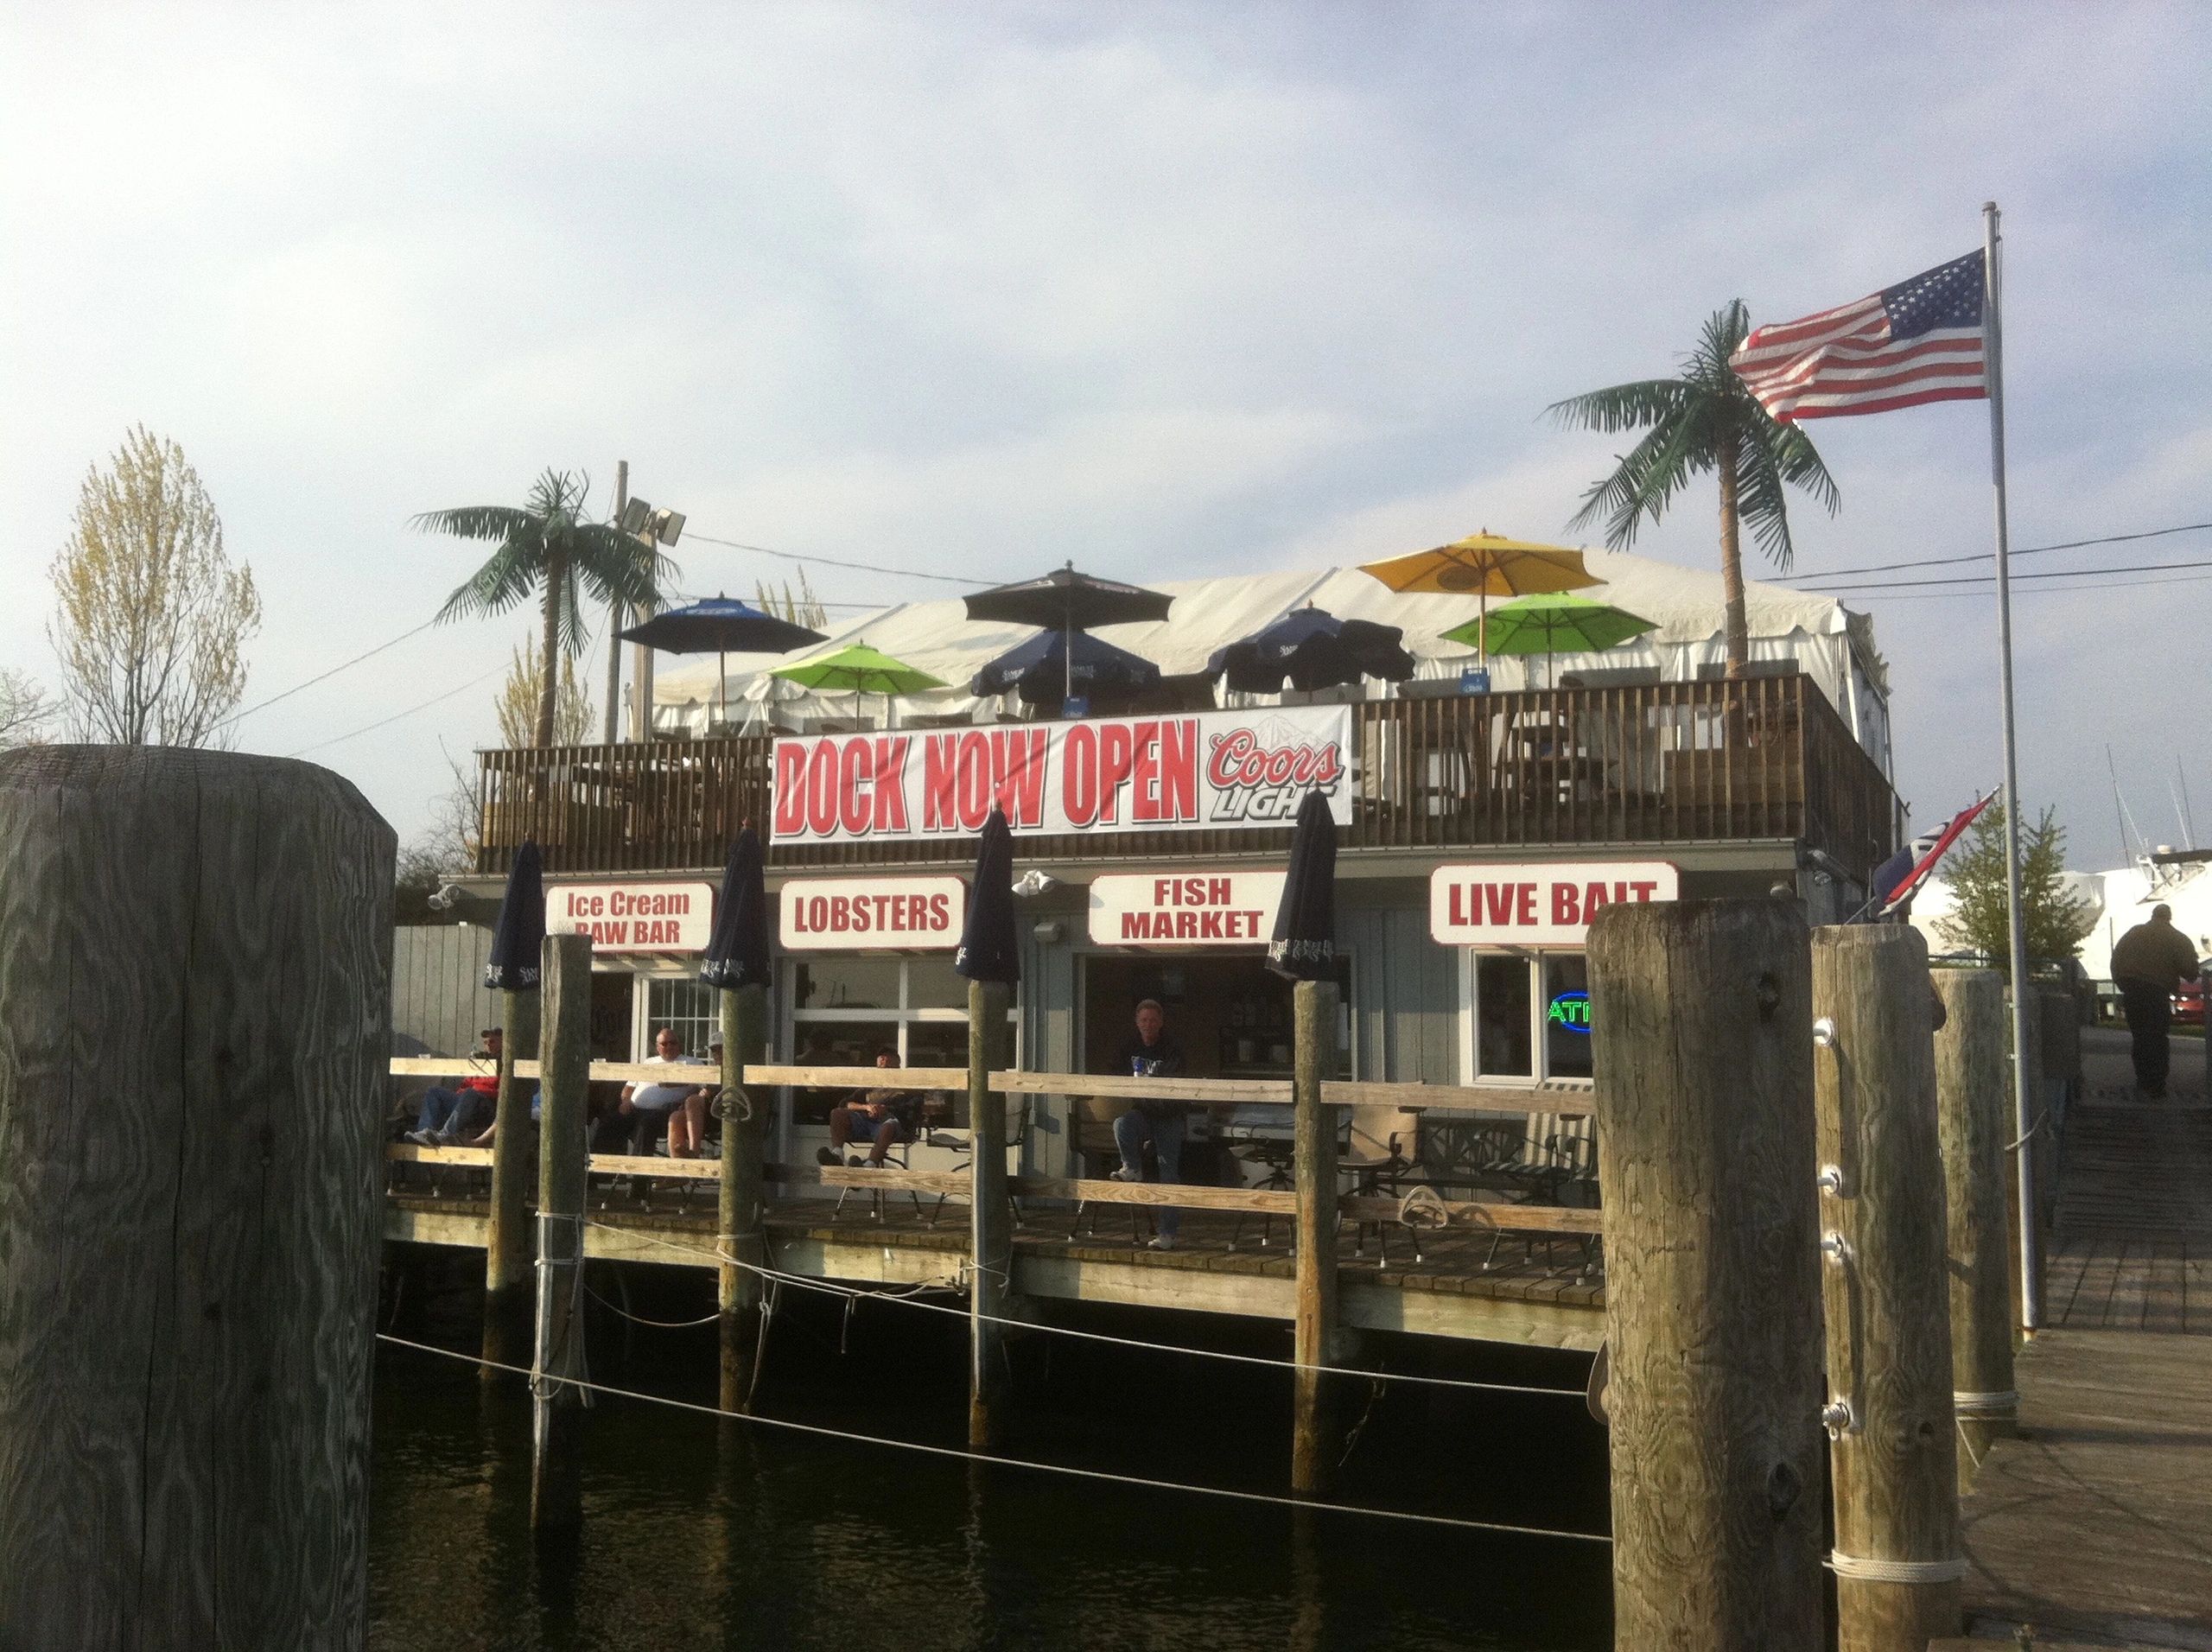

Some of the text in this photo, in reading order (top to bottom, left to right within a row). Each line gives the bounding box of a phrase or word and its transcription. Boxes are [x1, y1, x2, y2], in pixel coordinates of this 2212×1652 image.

[1207, 728, 1346, 790] Coors
[774, 718, 1198, 836] DOCK NOW OPEN
[568, 891, 690, 917] Ice Cream
[1154, 878, 1231, 906] FISH
[1450, 883, 1538, 926] LIVE
[795, 893, 950, 932] LOBSTERS
[1122, 911, 1262, 939] MARKET
[633, 920, 680, 944] BAR
